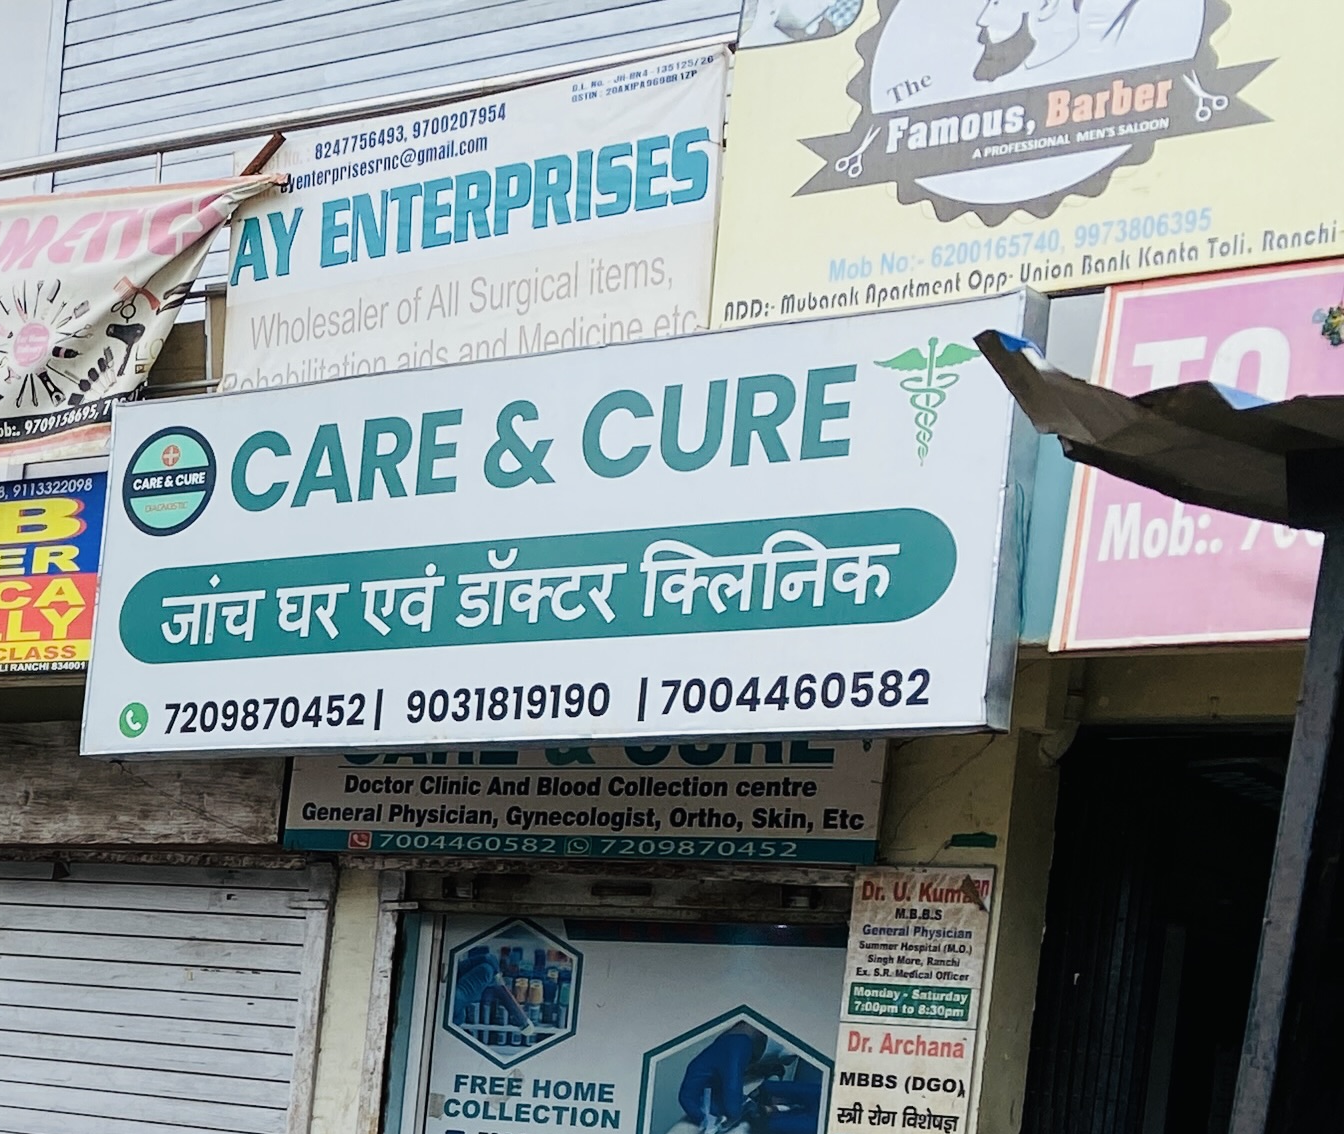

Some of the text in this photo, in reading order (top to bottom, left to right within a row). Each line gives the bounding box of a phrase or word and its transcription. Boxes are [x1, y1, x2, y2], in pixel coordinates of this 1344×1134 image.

[887, 71, 933, 106] The
[886, 77, 1174, 155] Famous, Barber
[1118, 117, 1170, 137] SALOON
[314, 126, 408, 162] 8247756493,
[412, 102, 507, 140] 9700207954
[320, 126, 711, 269] ENTERPRISES
[1020, 251, 1132, 284] Union Bank
[250, 255, 674, 351] Wholesaler of All Surgical items,
[459, 314, 644, 360] and Medicine
[231, 364, 858, 513] CARE & CURE
[12, 478, 95, 499] 9113322098
[133, 471, 206, 491] CARE CURE
[160, 528, 902, 646] जांच घर एवं डॉक्टर क्लिनिक
[164, 667, 931, 735] 7209870452 9031819190 7004460582
[344, 774, 818, 798] Doctor Clinic And Blood Collection centre
[301, 802, 866, 832] General Physician, Gynecologist, Ortho, Skin, Etc
[378, 832, 799, 859] 7004460582 7209870452
[861, 879, 886, 901] Dr.
[862, 923, 973, 940] General Physician
[853, 986, 969, 1005] Monday Saturday
[854, 1000, 964, 1019] 7:00pm 8:30pm
[847, 1030, 965, 1059] Dr. Archana
[454, 1074, 616, 1103] FREE HOME
[839, 1071, 966, 1098] MBBS (DGO)
[443, 1099, 621, 1130] COLLECTION
[836, 1101, 960, 1134] स्त्री रोग विशेषज्ञ
